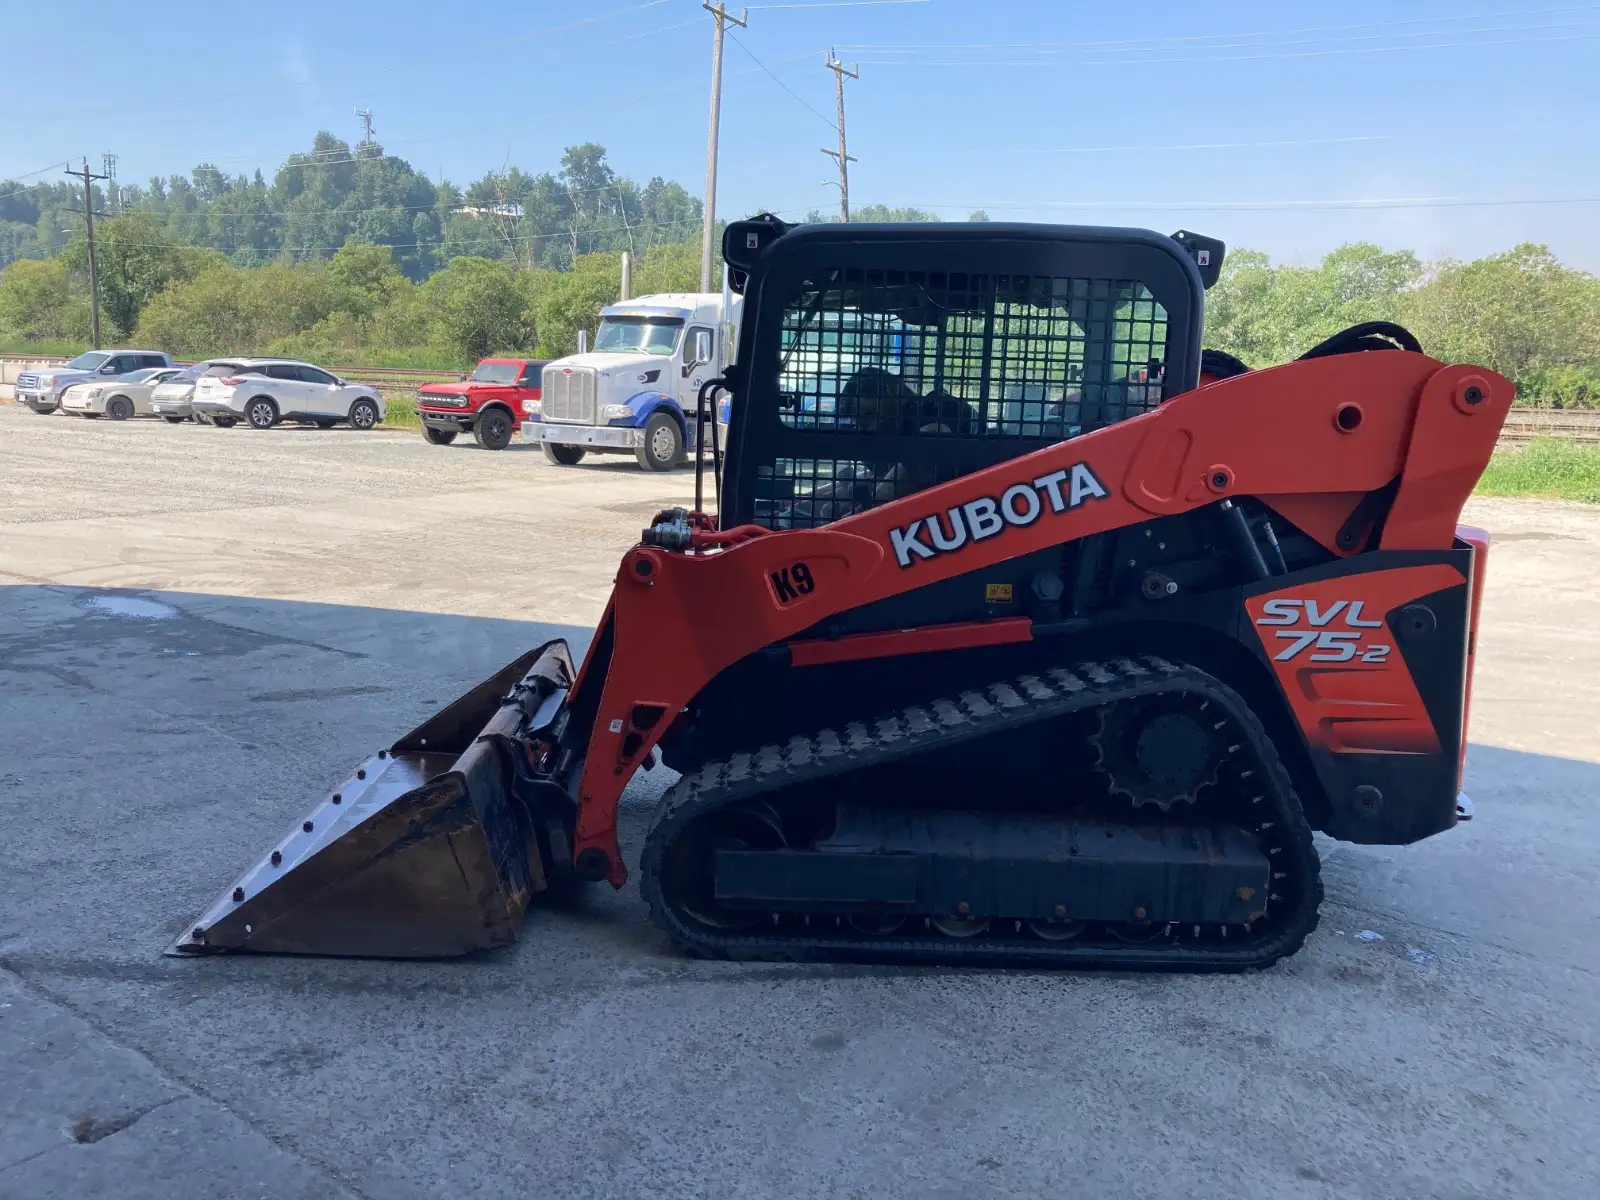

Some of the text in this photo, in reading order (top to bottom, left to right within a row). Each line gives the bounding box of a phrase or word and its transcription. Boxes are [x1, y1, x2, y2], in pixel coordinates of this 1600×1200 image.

[889, 462, 1107, 567] KUBOTA
[771, 562, 815, 603] K9
[1256, 599, 1382, 628] SVL
[1273, 630, 1391, 663] 75-2
